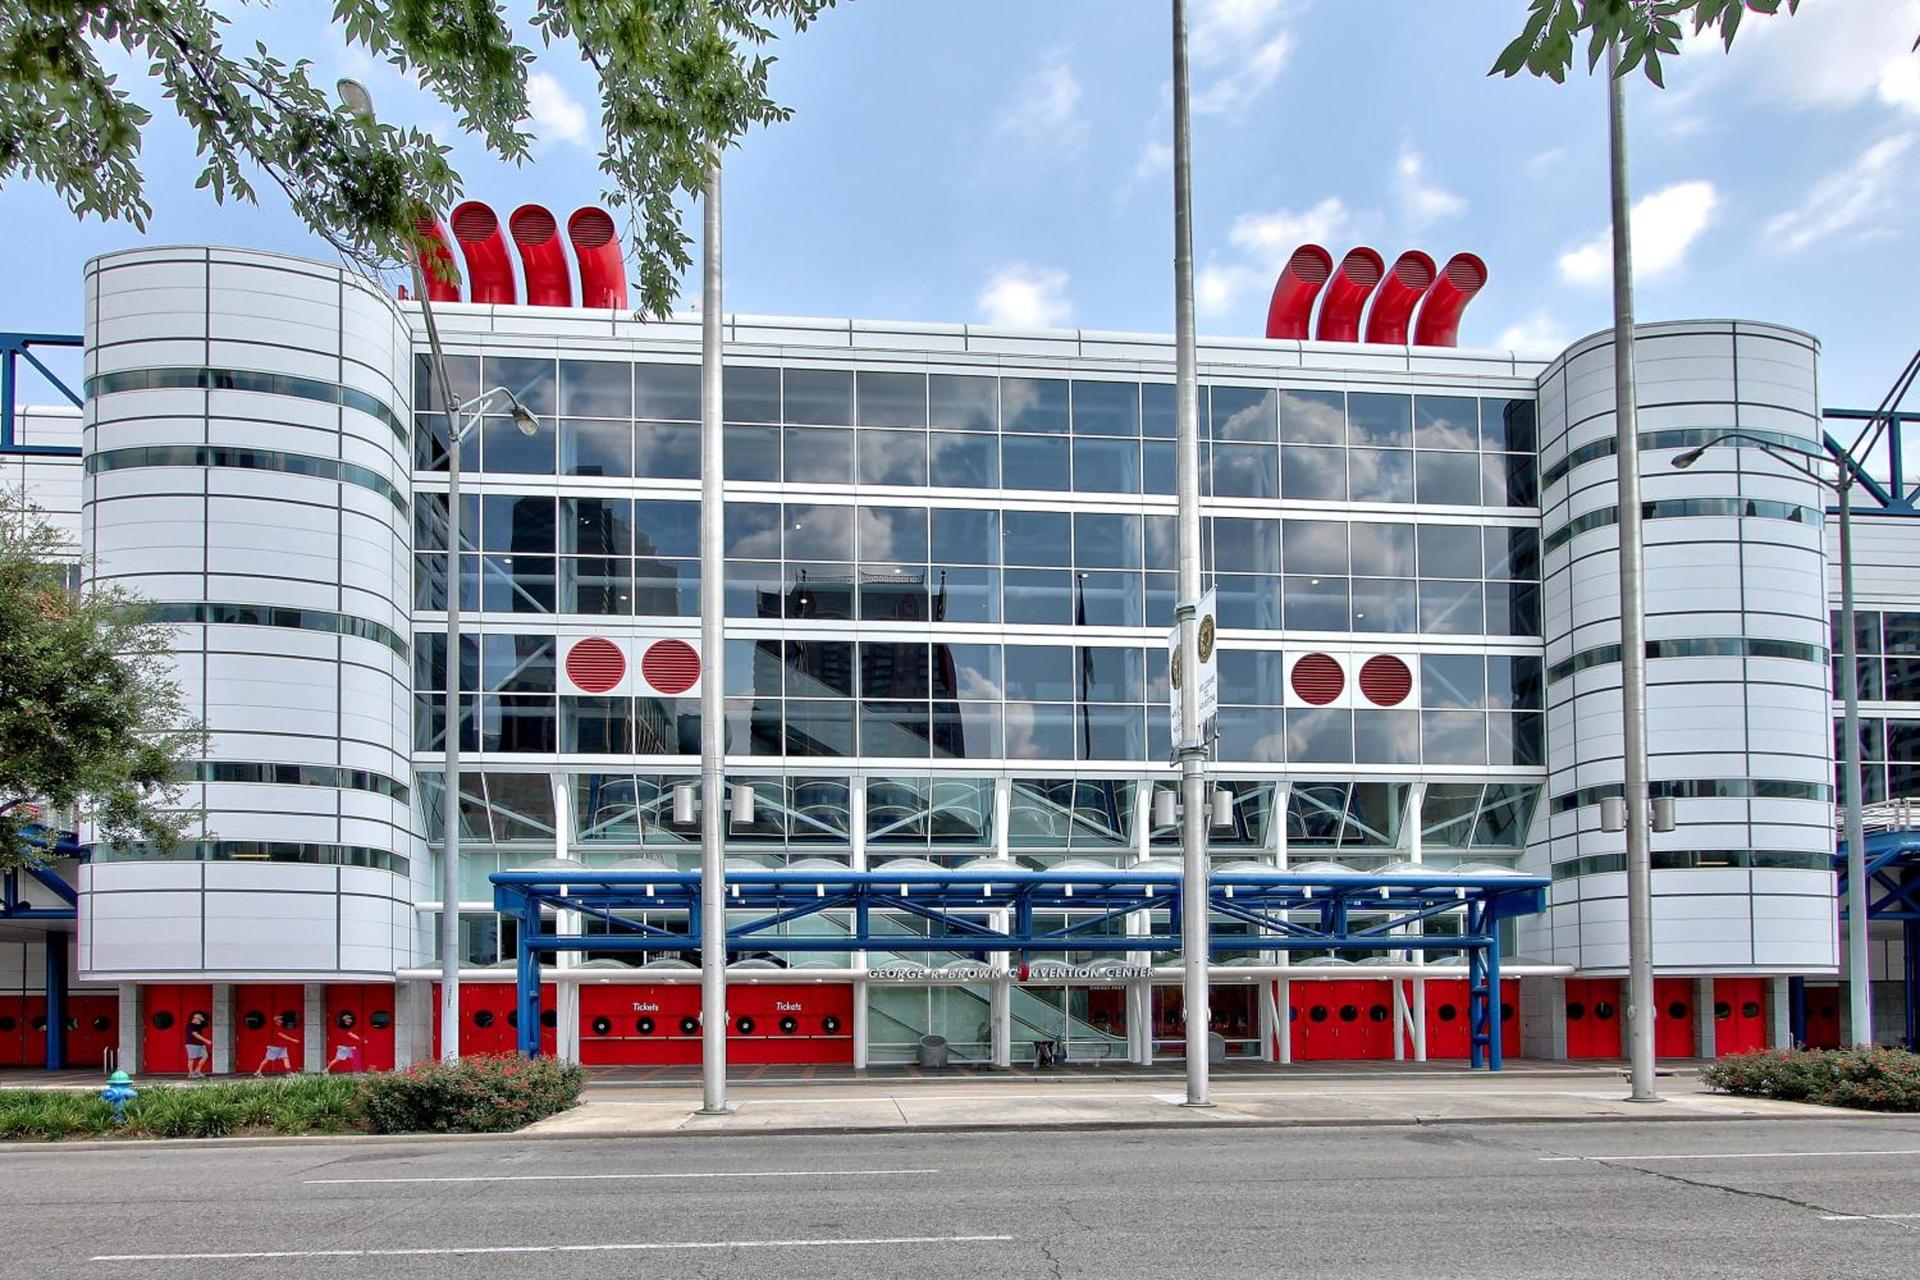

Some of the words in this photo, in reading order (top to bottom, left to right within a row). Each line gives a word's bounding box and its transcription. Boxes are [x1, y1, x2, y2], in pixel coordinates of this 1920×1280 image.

[868, 968, 925, 979] GEORGE
[931, 968, 944, 979] R.
[948, 968, 1001, 979] BROWN
[1008, 967, 1100, 979] CNVENTION
[1106, 967, 1155, 978] CENTER
[633, 1002, 659, 1011] Tickets
[776, 1001, 802, 1011] Tickets
